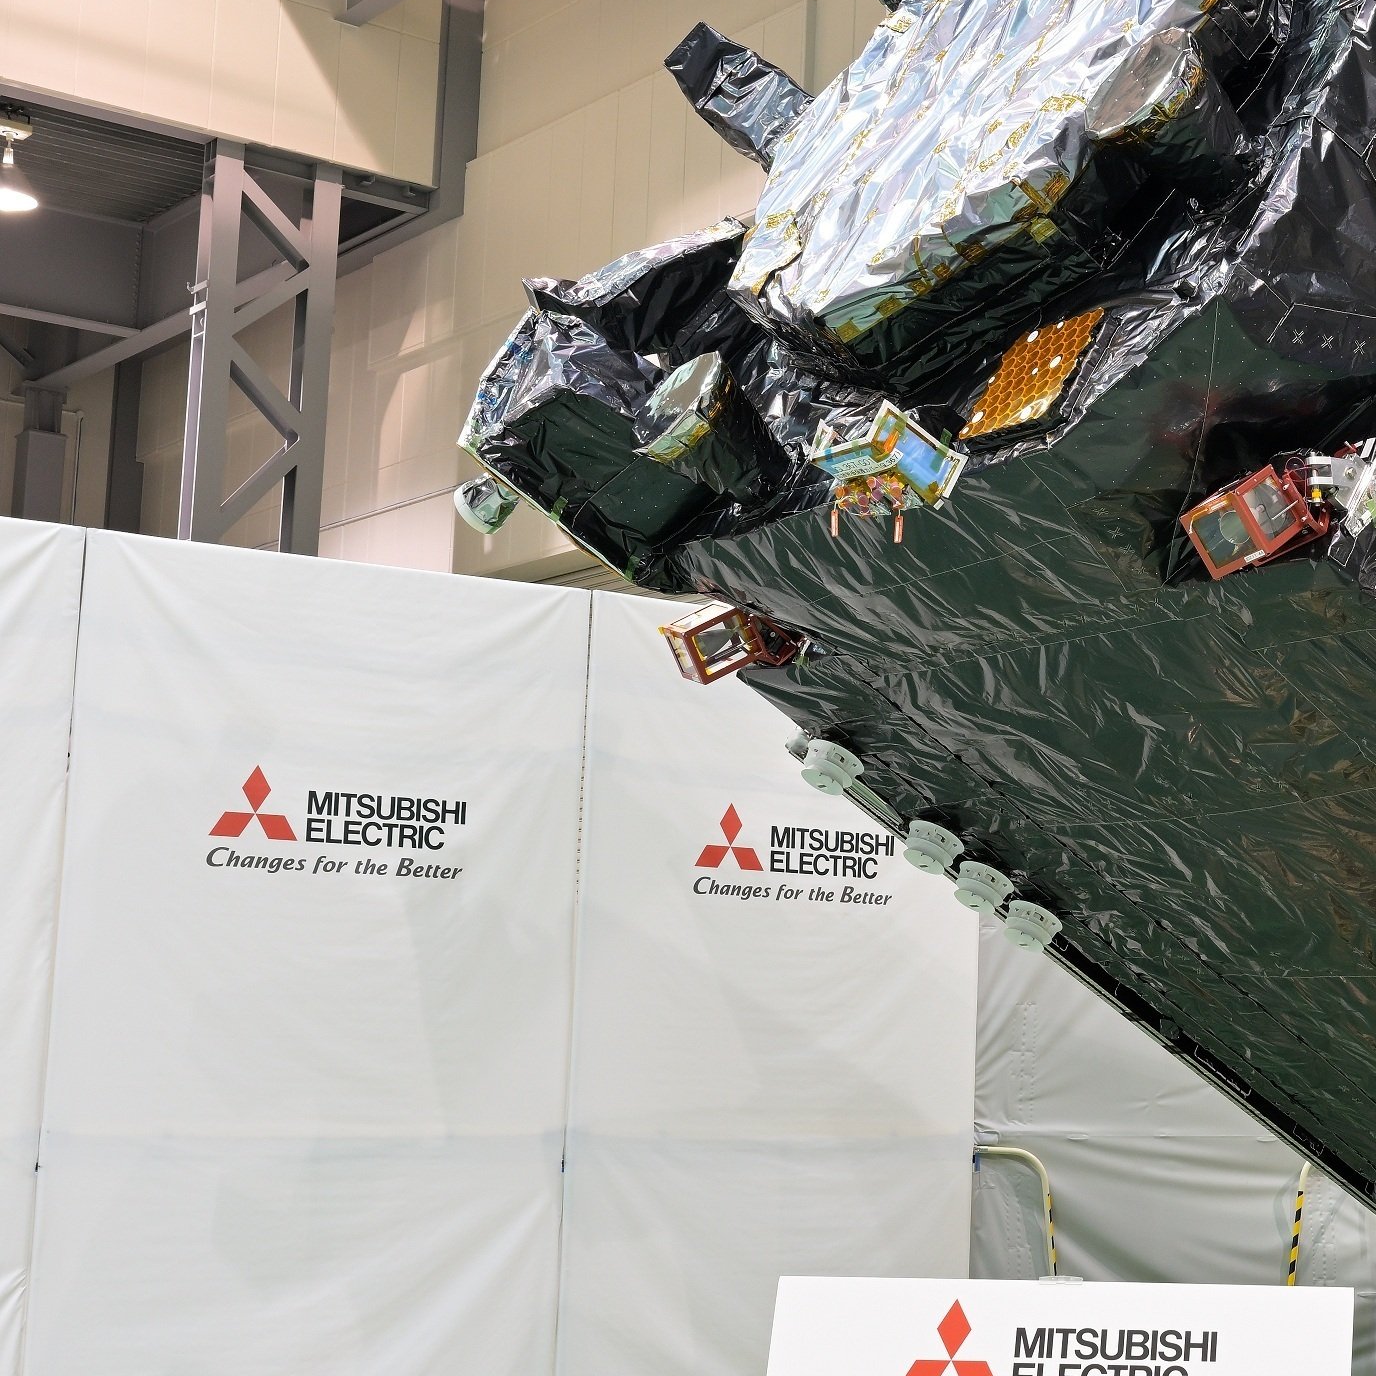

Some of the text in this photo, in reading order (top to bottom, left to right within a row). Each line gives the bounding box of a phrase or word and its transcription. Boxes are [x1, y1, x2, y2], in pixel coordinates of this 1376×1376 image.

[307, 790, 467, 825] MITSUBISHI
[305, 818, 445, 850] ELECTRIC
[770, 825, 895, 856] MITSUBISHI
[206, 846, 463, 880] Changes for the Better
[769, 850, 879, 879] ELECTRIC
[693, 876, 893, 906] Changes for the Better
[1013, 1327, 1218, 1362] MITSUBISHI
